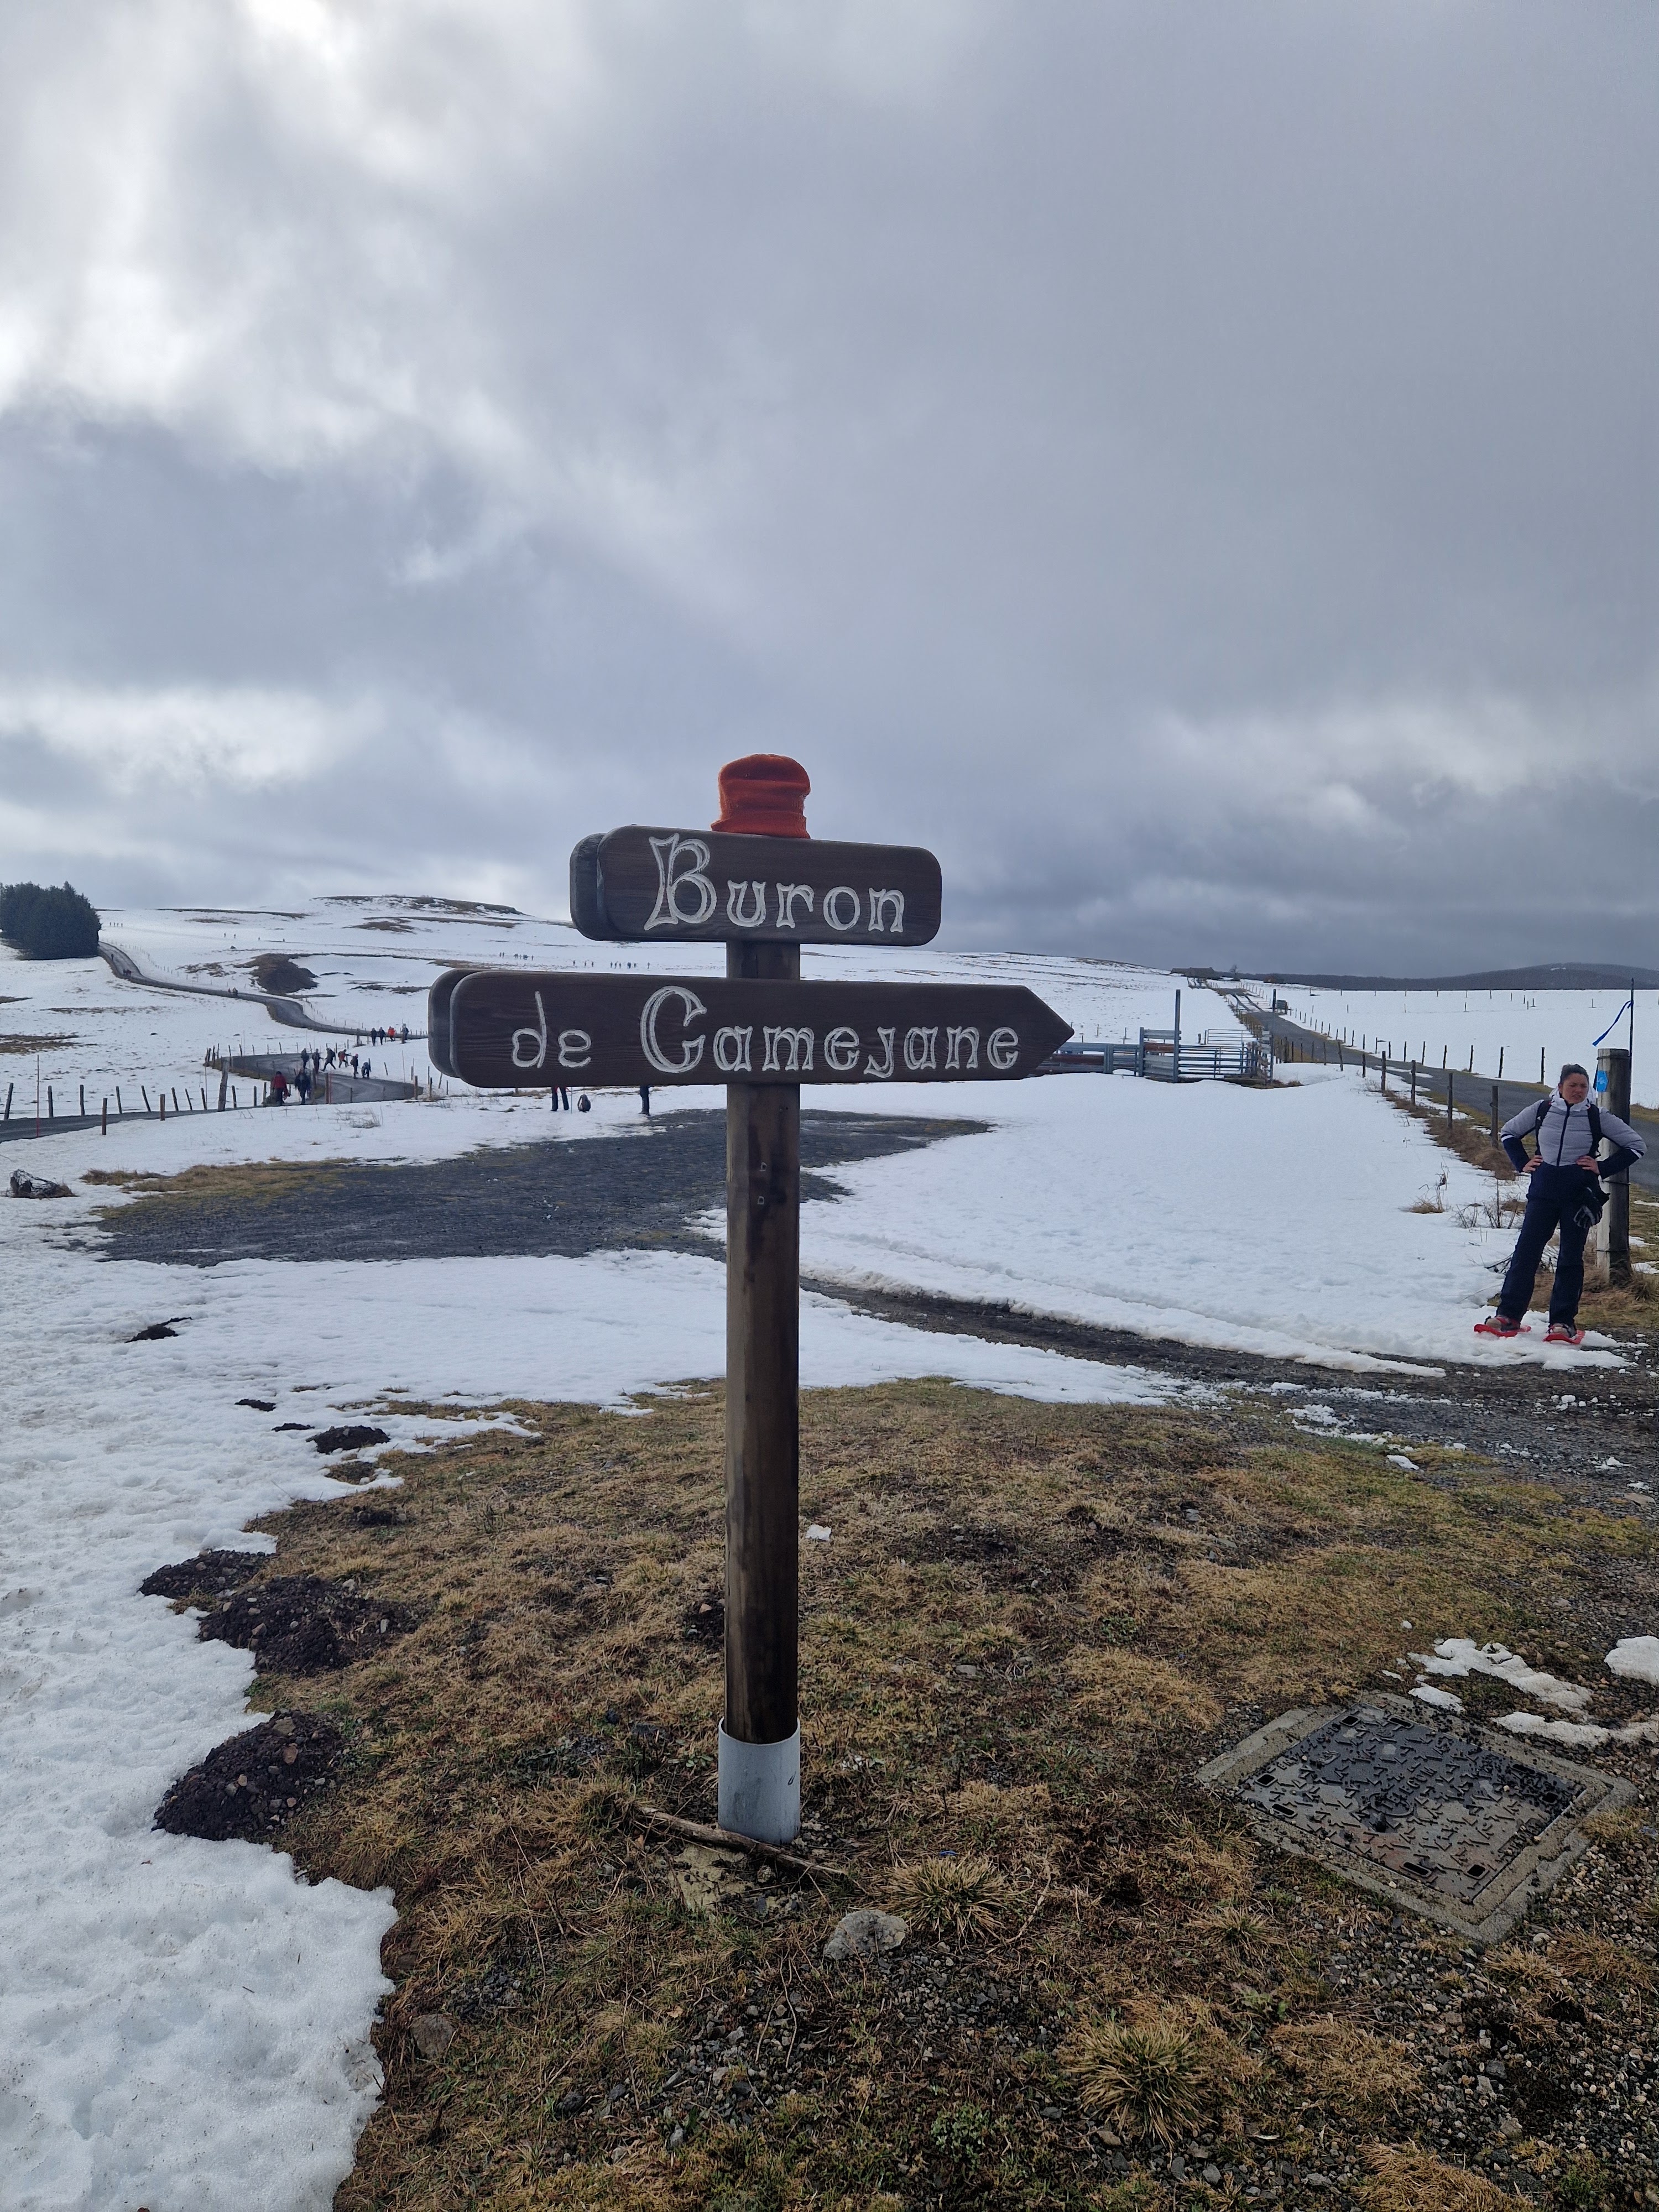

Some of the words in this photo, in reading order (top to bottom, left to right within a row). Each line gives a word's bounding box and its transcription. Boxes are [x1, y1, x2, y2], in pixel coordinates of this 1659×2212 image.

[644, 832, 904, 933] Buron
[512, 991, 591, 1068] de
[640, 985, 1019, 1078] Camejane
